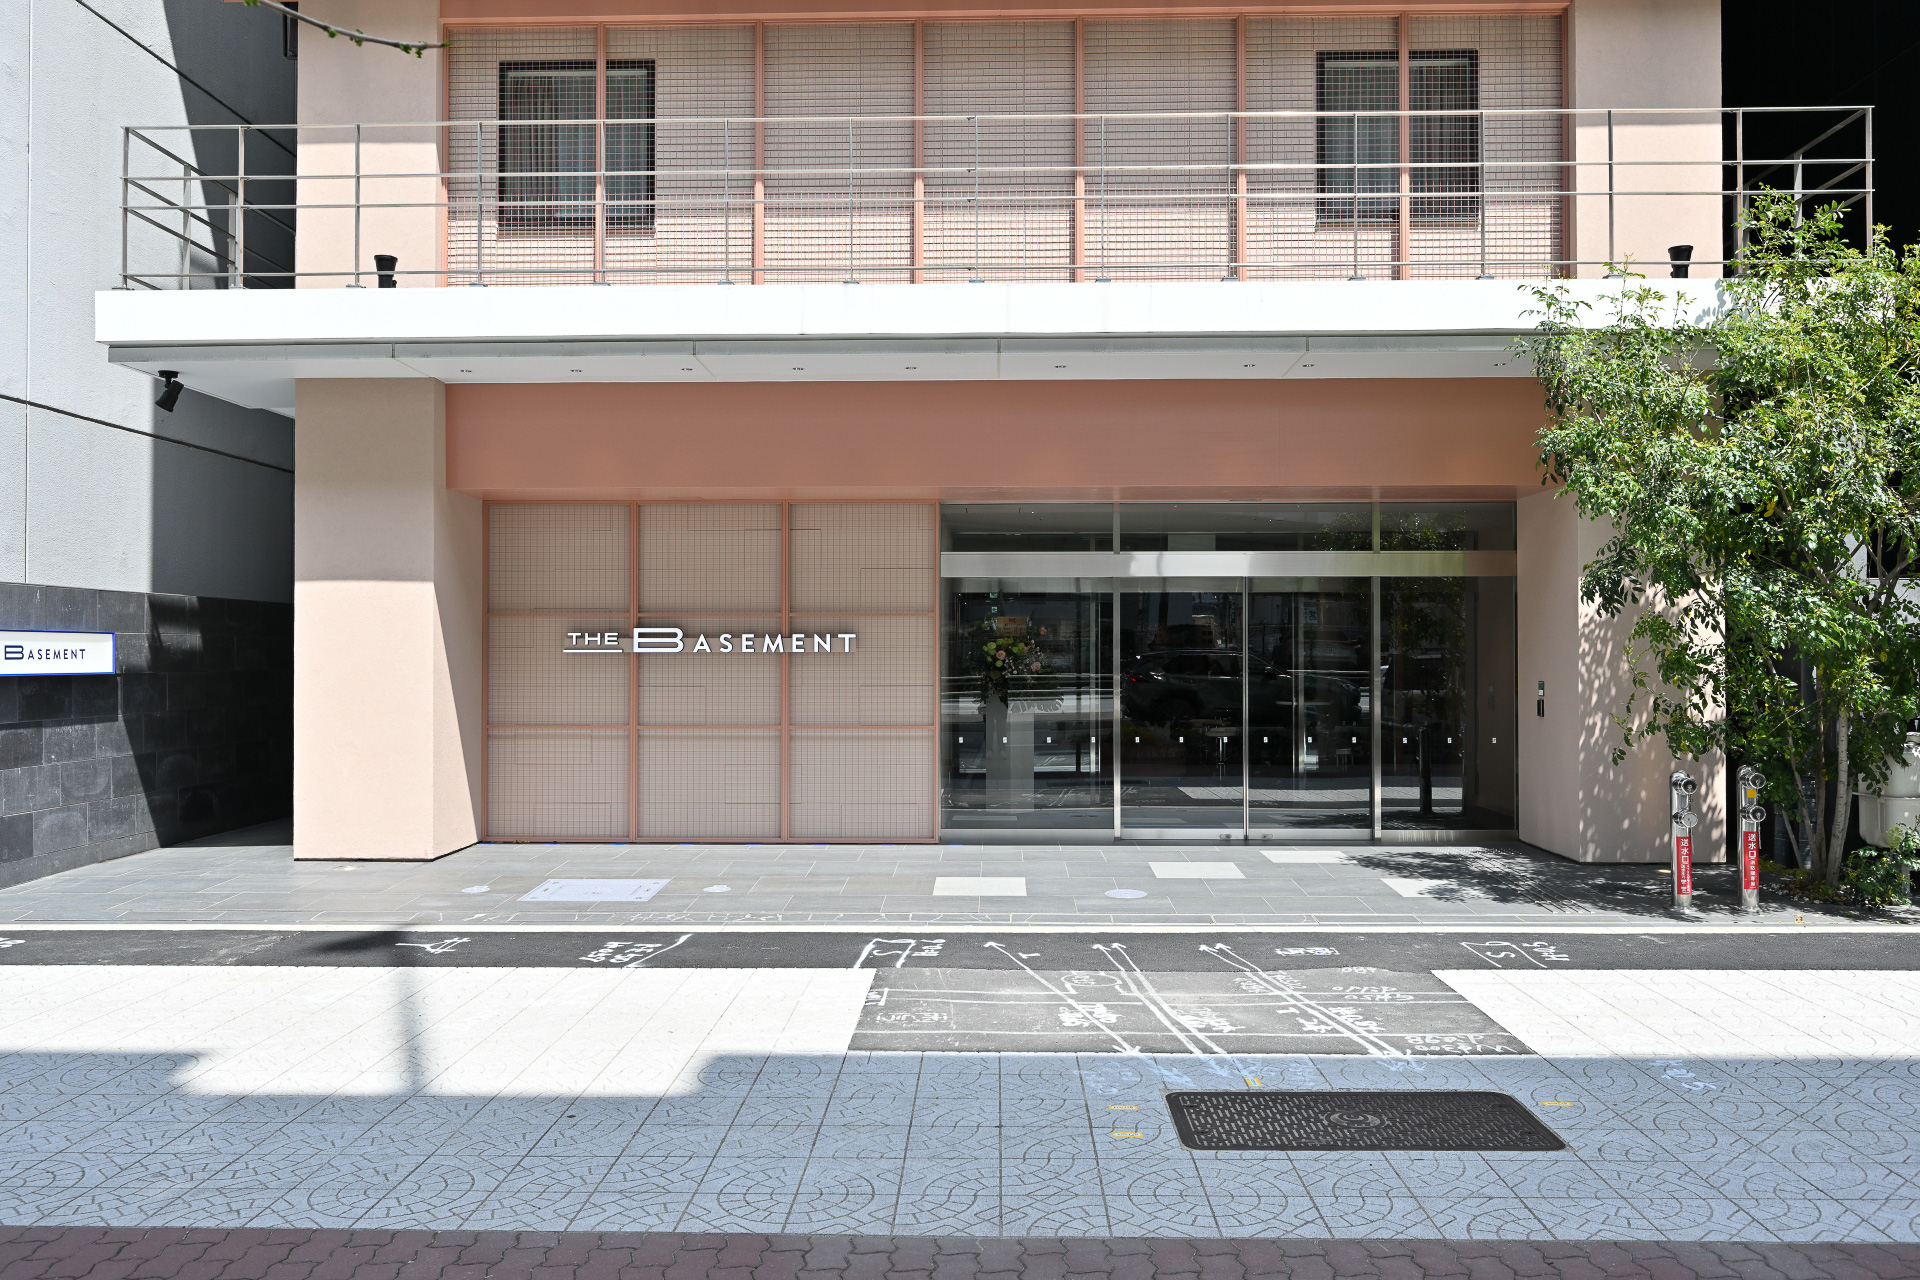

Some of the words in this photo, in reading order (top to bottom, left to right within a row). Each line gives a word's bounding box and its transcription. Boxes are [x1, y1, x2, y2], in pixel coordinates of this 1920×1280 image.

[4, 644, 86, 661] BASEMENT
[567, 632, 620, 646] THE
[633, 627, 857, 653] BASEMENT
[1681, 838, 1689, 863] 送水口
[1748, 833, 1757, 858] 送水口
